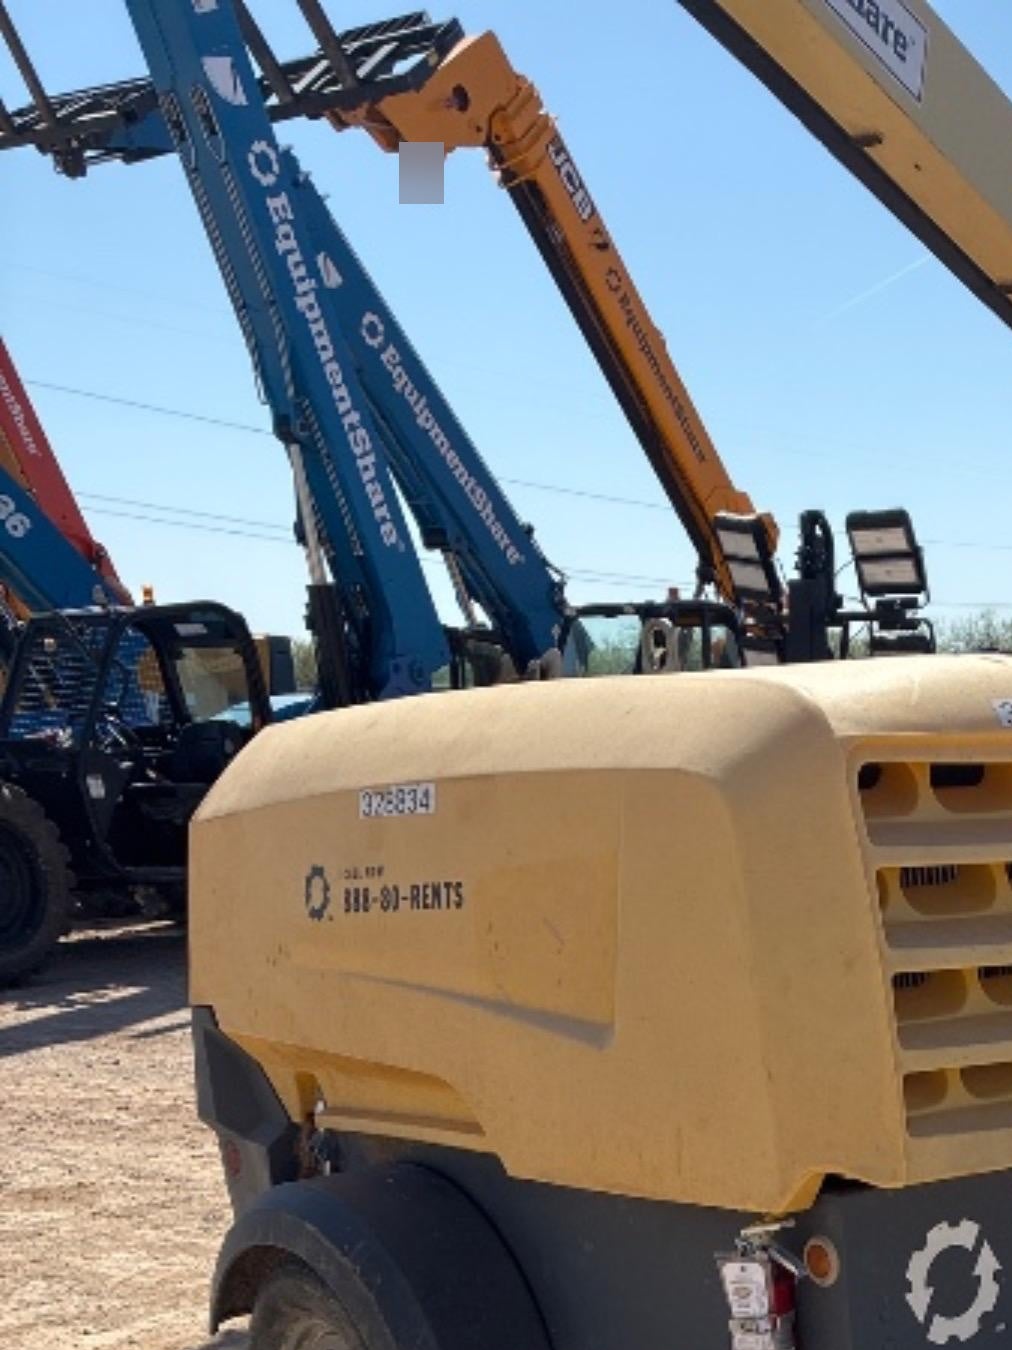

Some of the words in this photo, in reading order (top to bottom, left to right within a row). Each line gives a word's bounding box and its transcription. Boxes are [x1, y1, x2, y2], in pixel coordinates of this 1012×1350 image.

[266, 192, 398, 548] EquipmentShare
[381, 344, 520, 565] EquipmentShare
[361, 787, 431, 818] 328834
